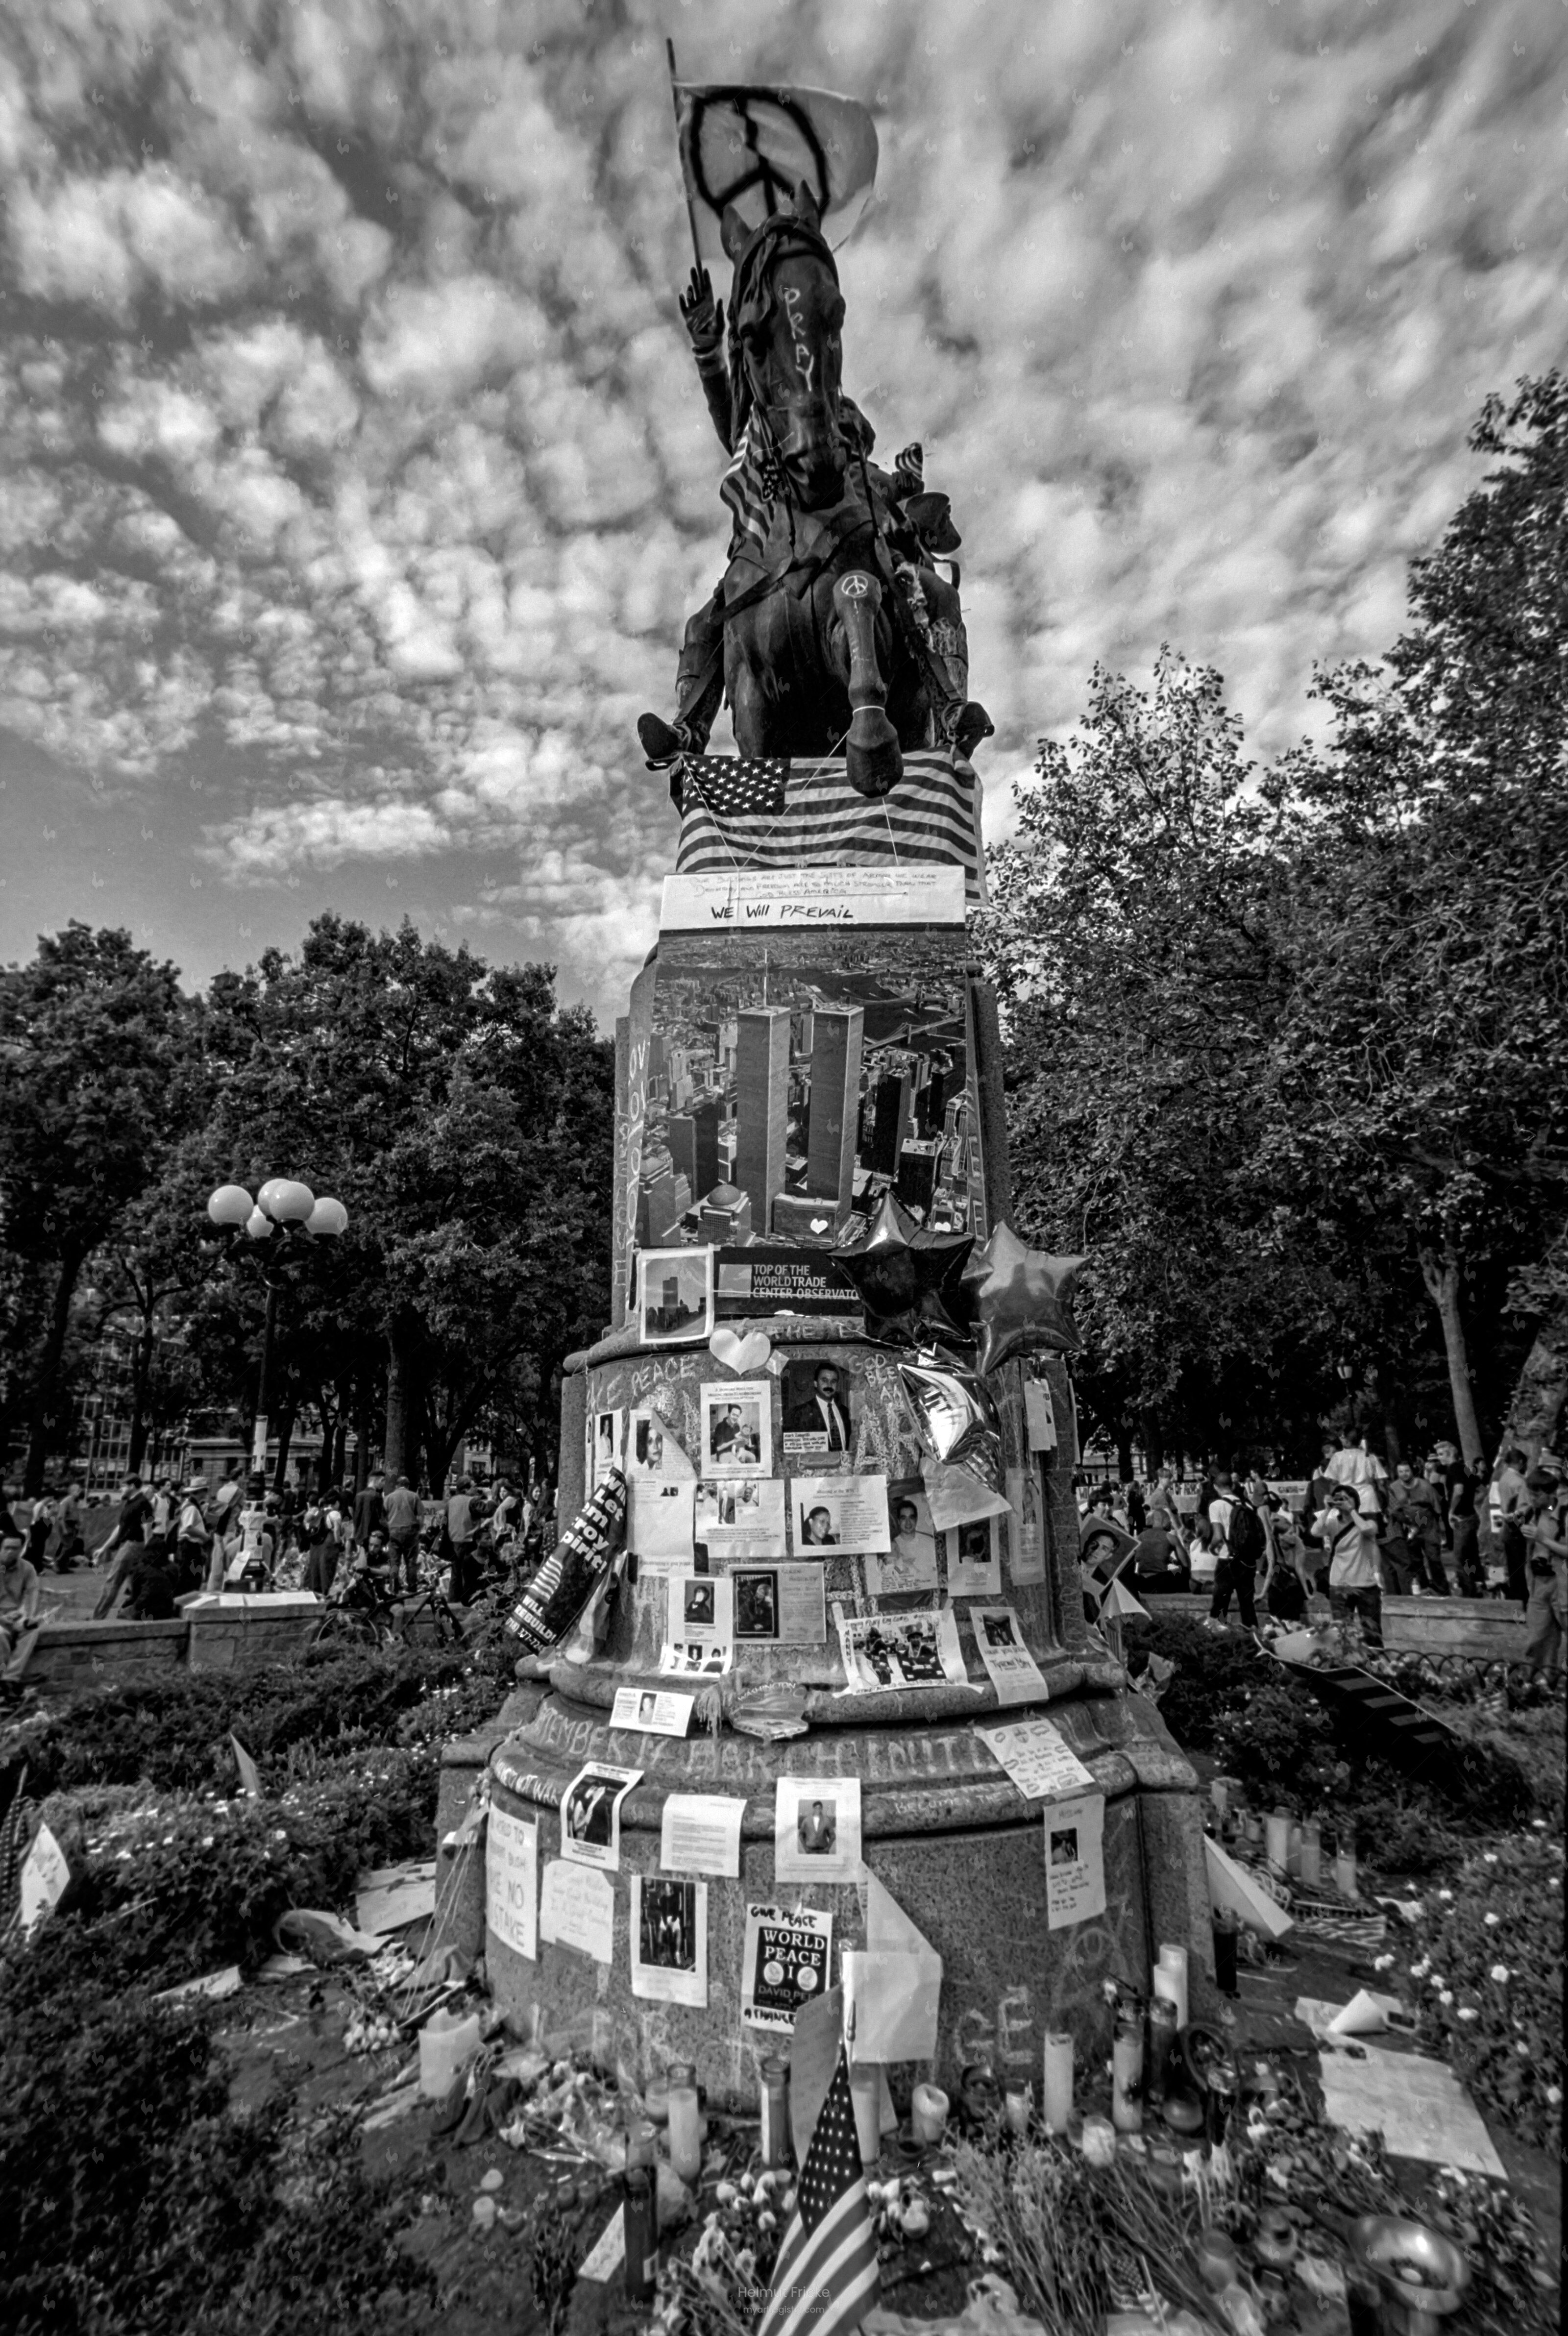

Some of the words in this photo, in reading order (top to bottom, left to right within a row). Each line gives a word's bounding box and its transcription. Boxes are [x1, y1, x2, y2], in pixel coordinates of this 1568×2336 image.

[784, 287, 815, 393] PRAY
[711, 906, 735, 919] WE
[754, 1264, 775, 1275] TOP
[774, 1265, 789, 1275] OF
[790, 1265, 810, 1276] THE
[753, 1276, 791, 1287] WORLD
[792, 1277, 827, 1288] TRADE
[752, 1287, 793, 1299] CENTER
[796, 1288, 858, 1300] OBSERVATO
[631, 1354, 700, 1397] PEACE
[864, 1366, 898, 1387] BLE
[593, 1488, 623, 1522] Let
[522, 1594, 543, 1617] WILL
[514, 1604, 557, 1643] REBUILD!
[750, 1906, 776, 1921] GIVE
[781, 1911, 818, 1929] PEACE
[763, 1929, 826, 1950] WORLD
[764, 1945, 821, 1967] PEACE
[759, 1985, 791, 1998] DAVID
[744, 2007, 752, 2020] A
